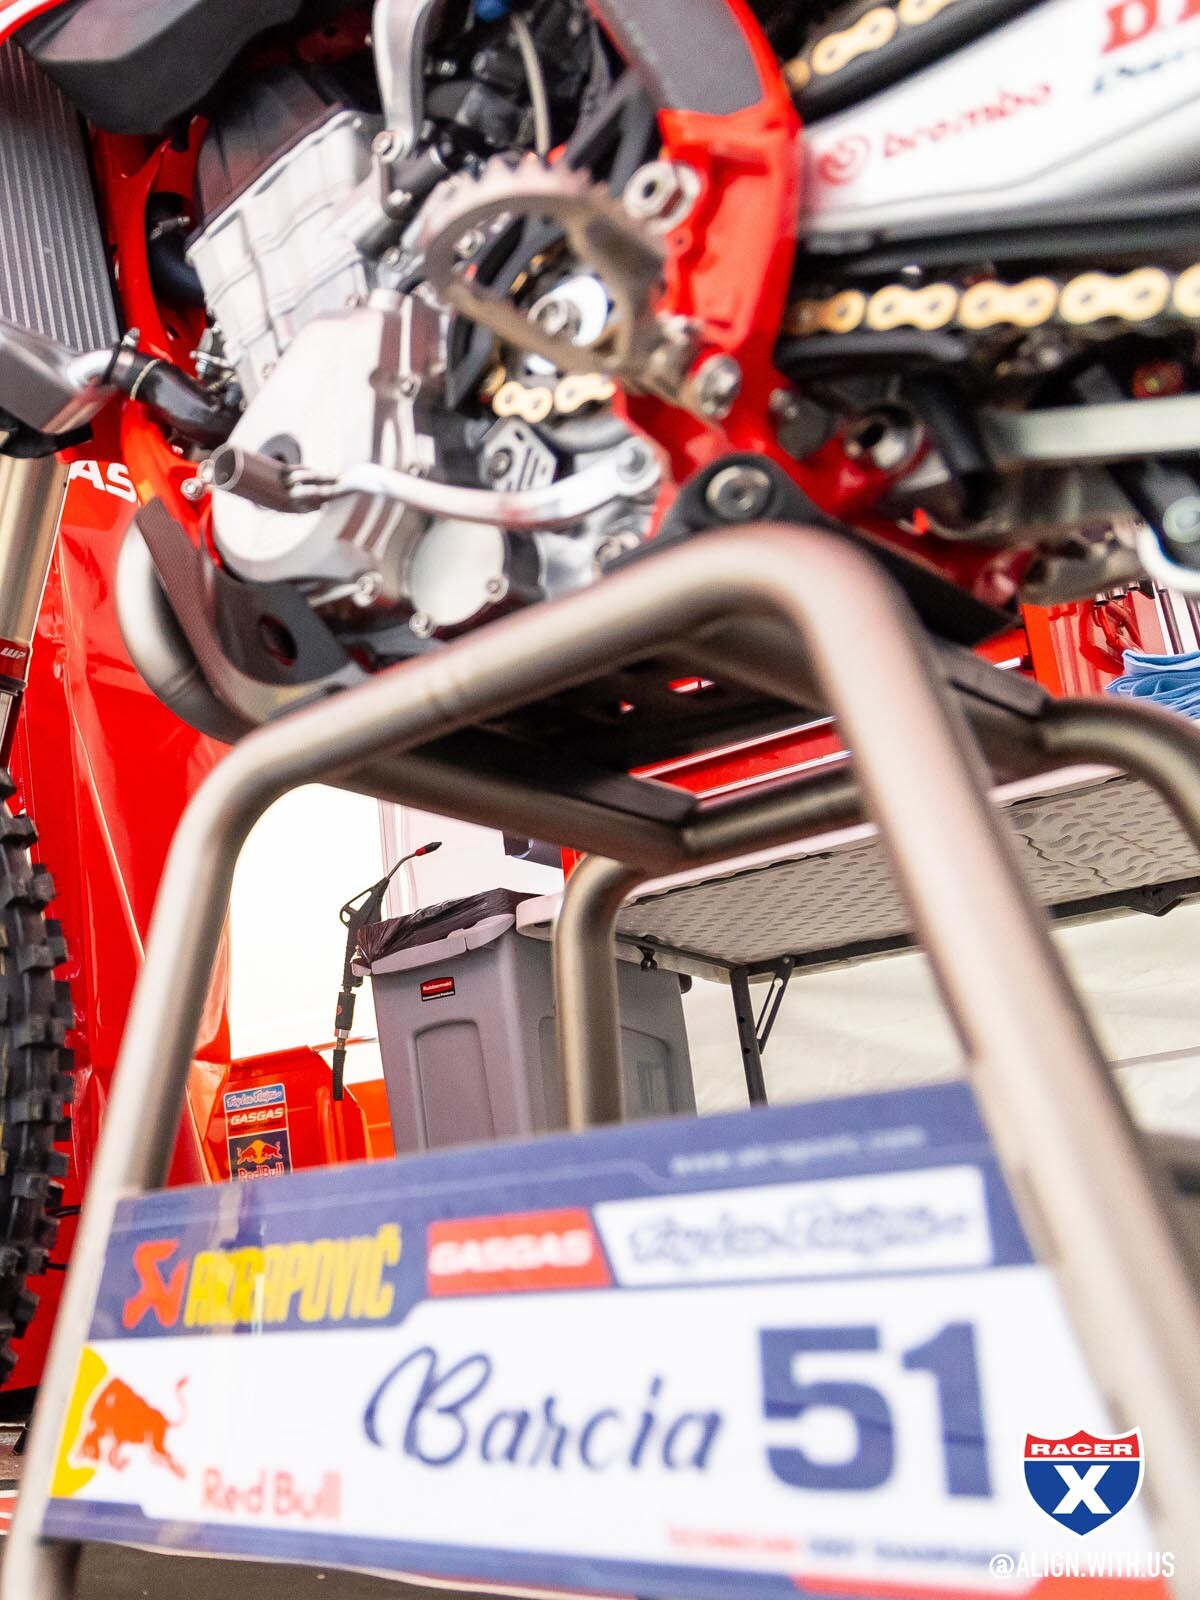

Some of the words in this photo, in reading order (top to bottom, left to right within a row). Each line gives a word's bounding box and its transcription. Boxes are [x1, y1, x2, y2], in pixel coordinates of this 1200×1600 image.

[0, 647, 27, 659] WP
[230, 1107, 284, 1126] GASGAS
[427, 1229, 592, 1277] GASGAS
[363, 1345, 722, 1475] Barcia
[759, 1321, 994, 1499] 51
[203, 1467, 267, 1516] Red
[274, 1470, 342, 1521] Bull
